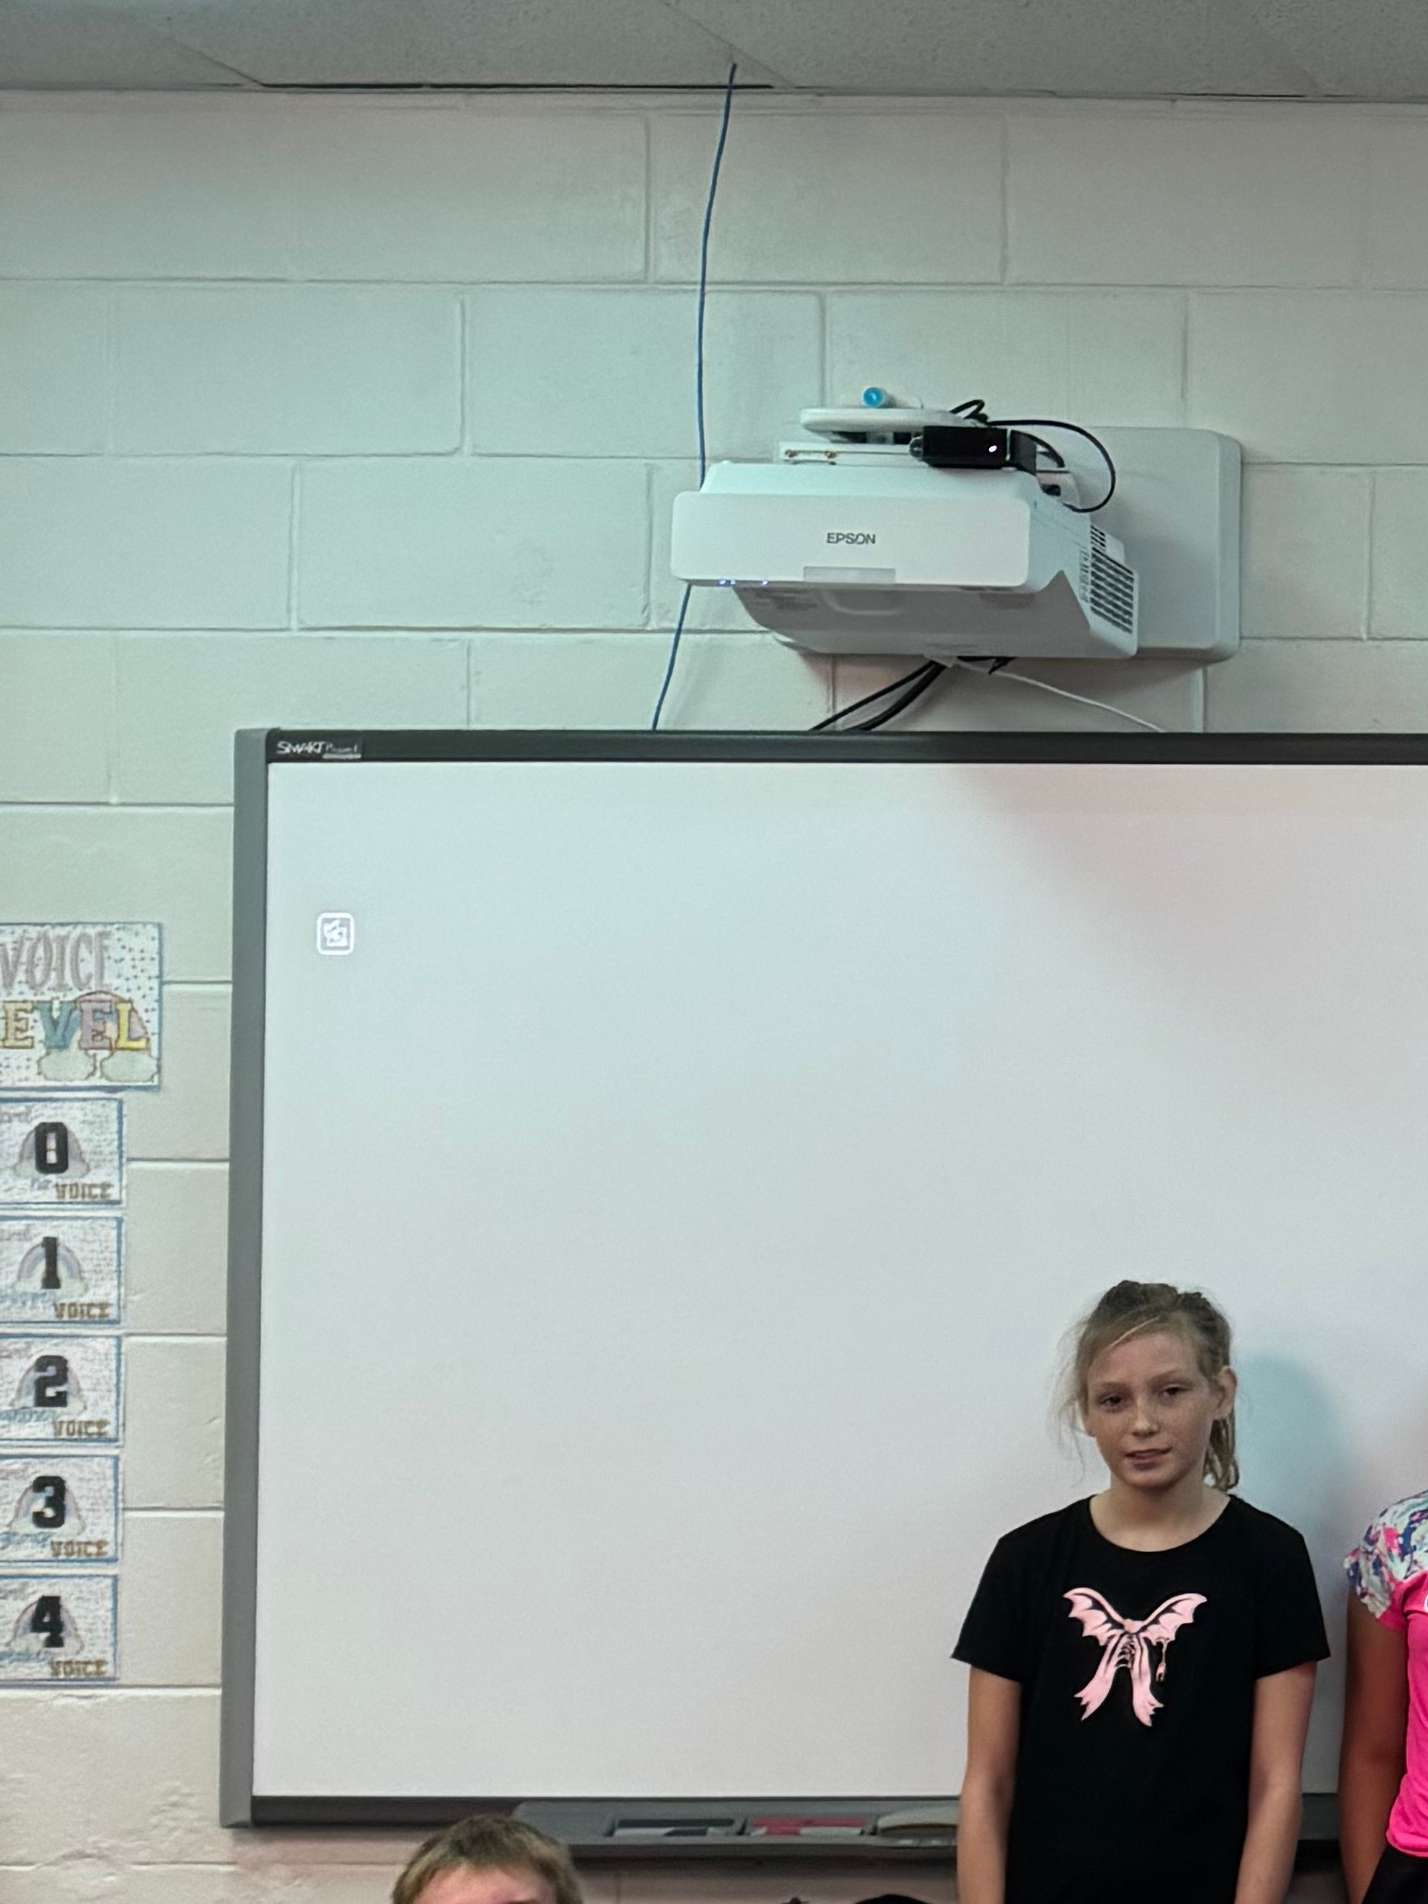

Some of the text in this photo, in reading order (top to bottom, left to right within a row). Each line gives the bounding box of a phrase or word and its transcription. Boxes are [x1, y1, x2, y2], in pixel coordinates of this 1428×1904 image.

[826, 532, 876, 546] EPSON
[0, 930, 113, 992] VOICE
[0, 999, 150, 1052] EVEL
[34, 1121, 69, 1174] 0
[54, 1182, 115, 1201] VOICE
[41, 1236, 61, 1290] 1
[53, 1302, 112, 1320] VOICE
[34, 1355, 69, 1408] 2
[52, 1419, 111, 1437] VOICE
[32, 1475, 66, 1529] 3
[50, 1540, 109, 1558] VOICE
[31, 1595, 65, 1649] 4
[50, 1660, 109, 1678] VOICE
